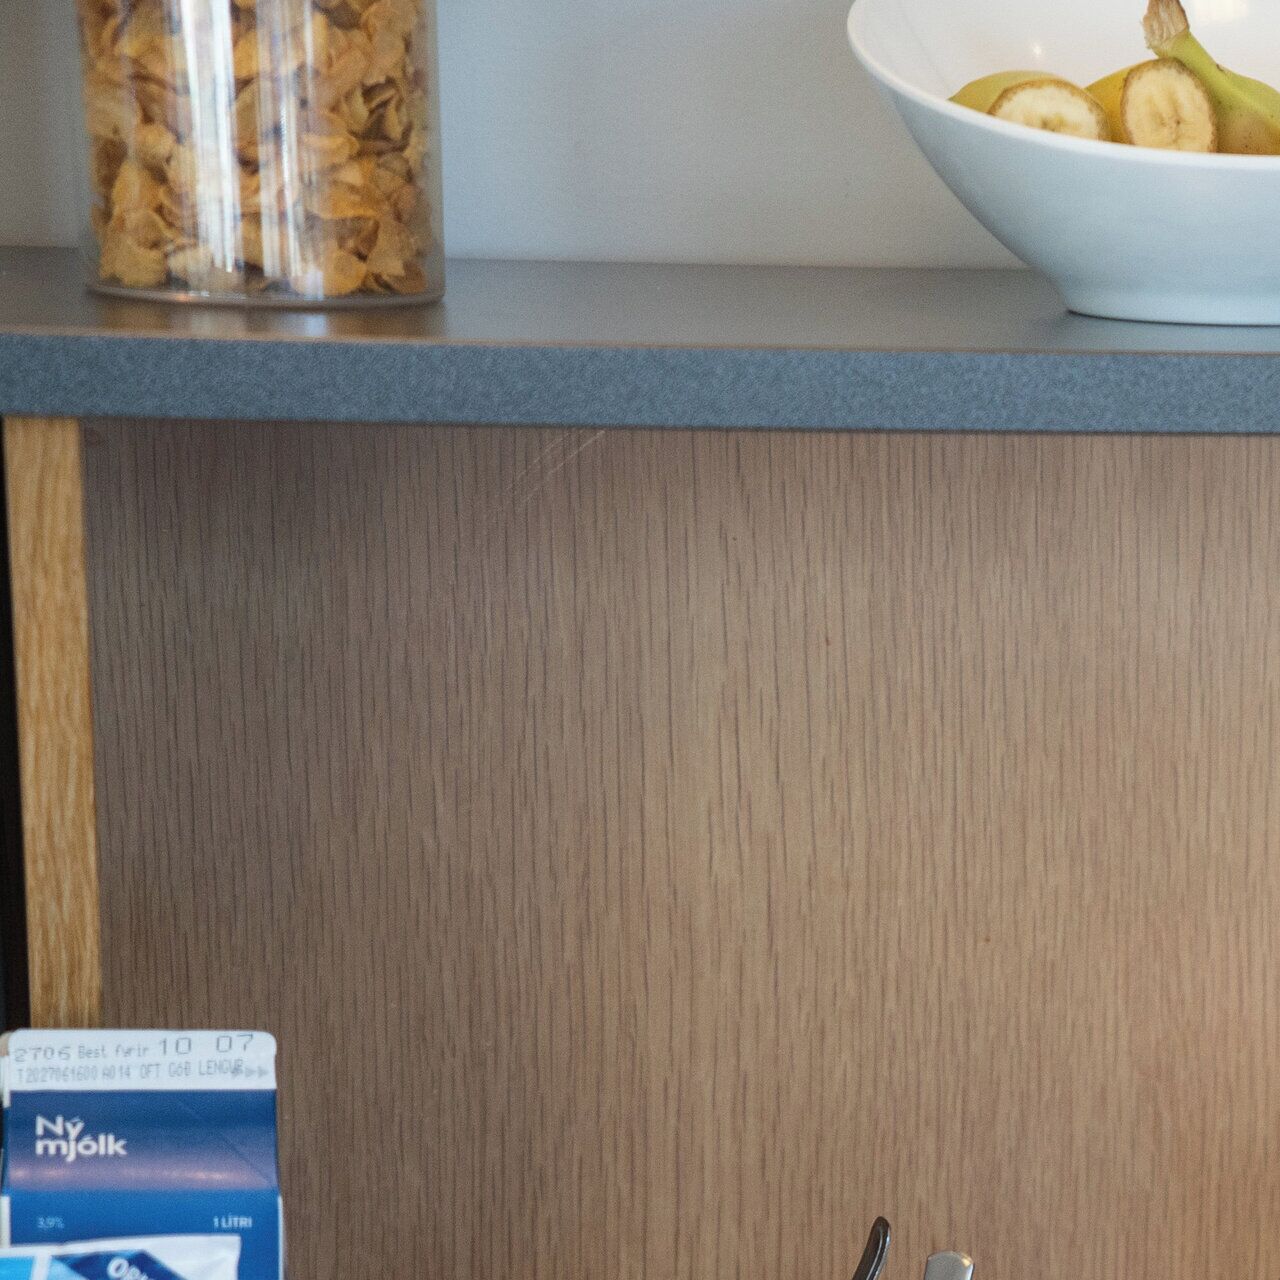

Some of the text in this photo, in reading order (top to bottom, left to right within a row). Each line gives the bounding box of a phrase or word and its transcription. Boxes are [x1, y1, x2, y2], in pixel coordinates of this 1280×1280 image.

[160, 1037, 191, 1054] 10
[216, 1033, 253, 1052] 07
[36, 1115, 84, 1142] Ný
[35, 1133, 128, 1162] mjólk
[213, 1216, 219, 1228] 1
